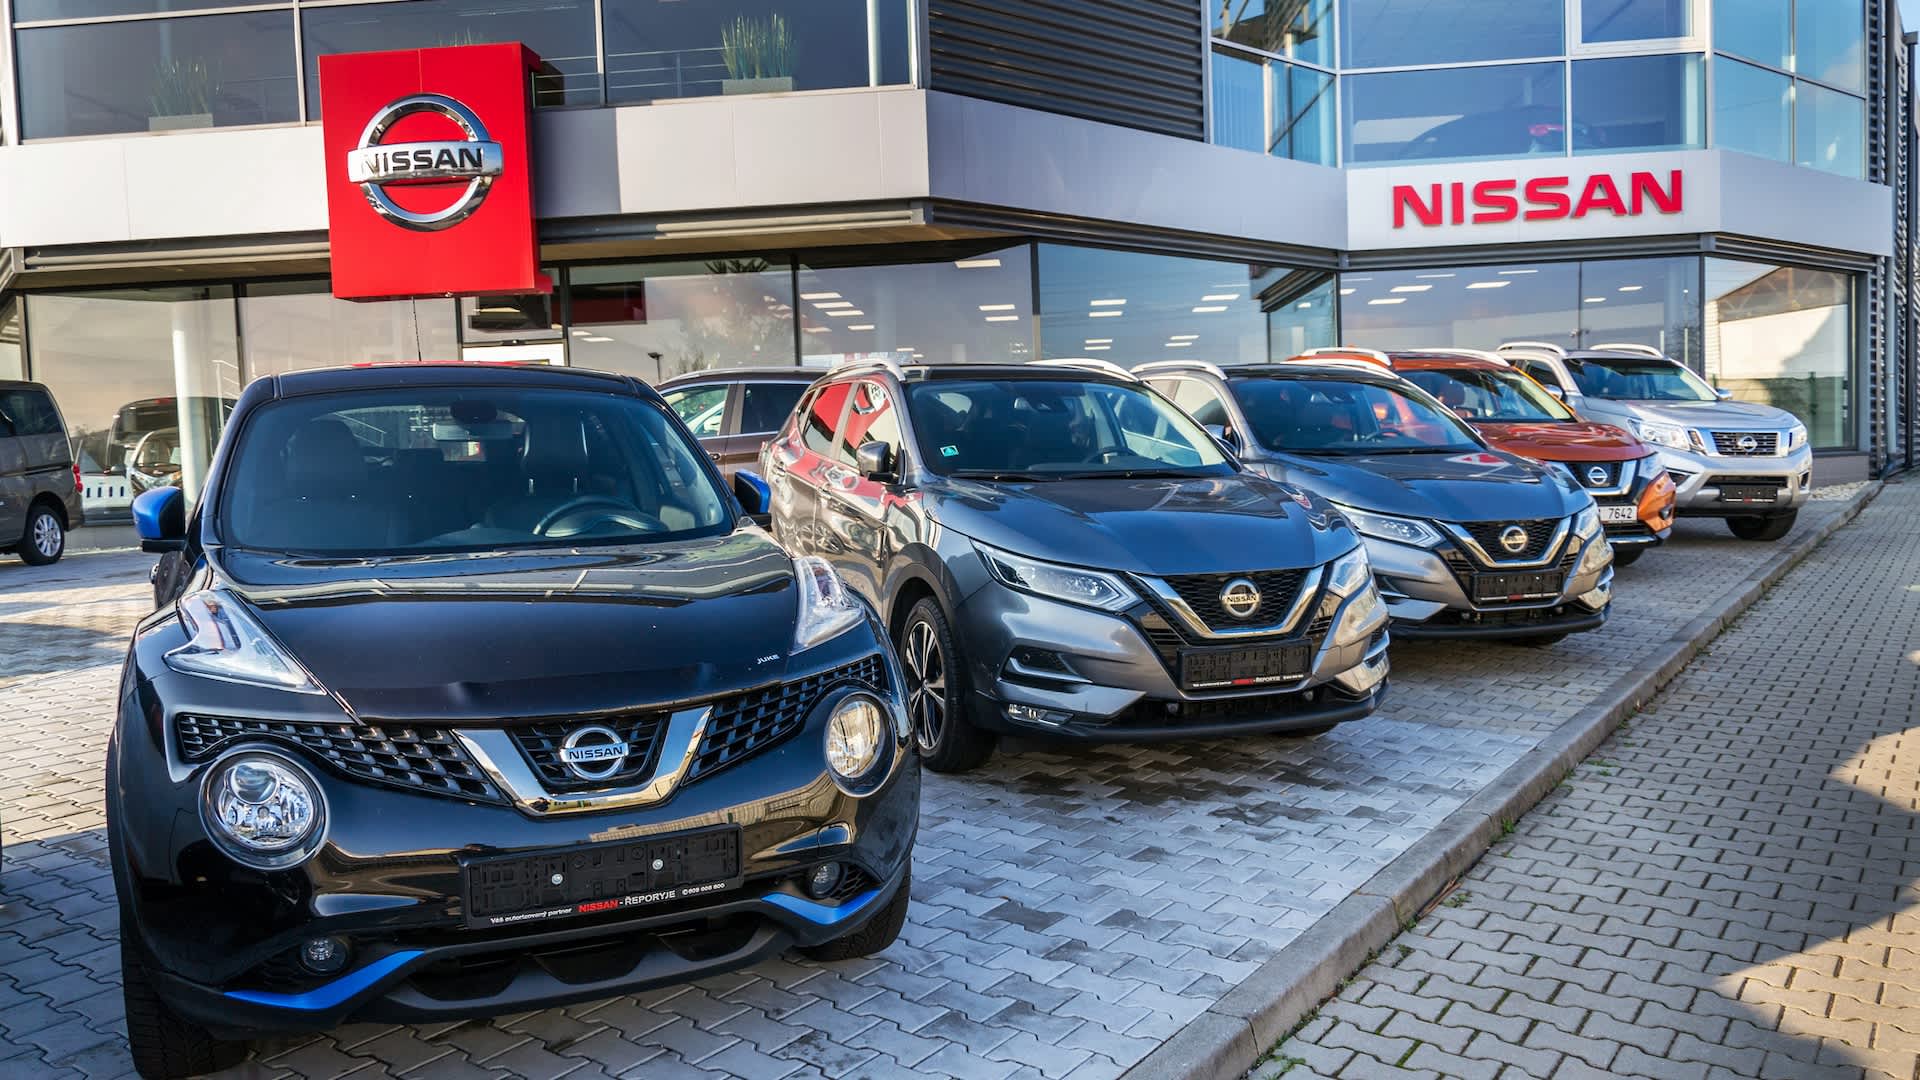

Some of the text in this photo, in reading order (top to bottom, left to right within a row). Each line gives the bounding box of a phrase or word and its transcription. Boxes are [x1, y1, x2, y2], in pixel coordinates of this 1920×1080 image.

[361, 148, 482, 174] NISSAN
[1393, 169, 1683, 228] NISSAN
[1608, 507, 1633, 519] 7642
[757, 654, 780, 665] JUKE
[568, 746, 623, 760] NISSAN
[577, 899, 619, 912] NISSAN
